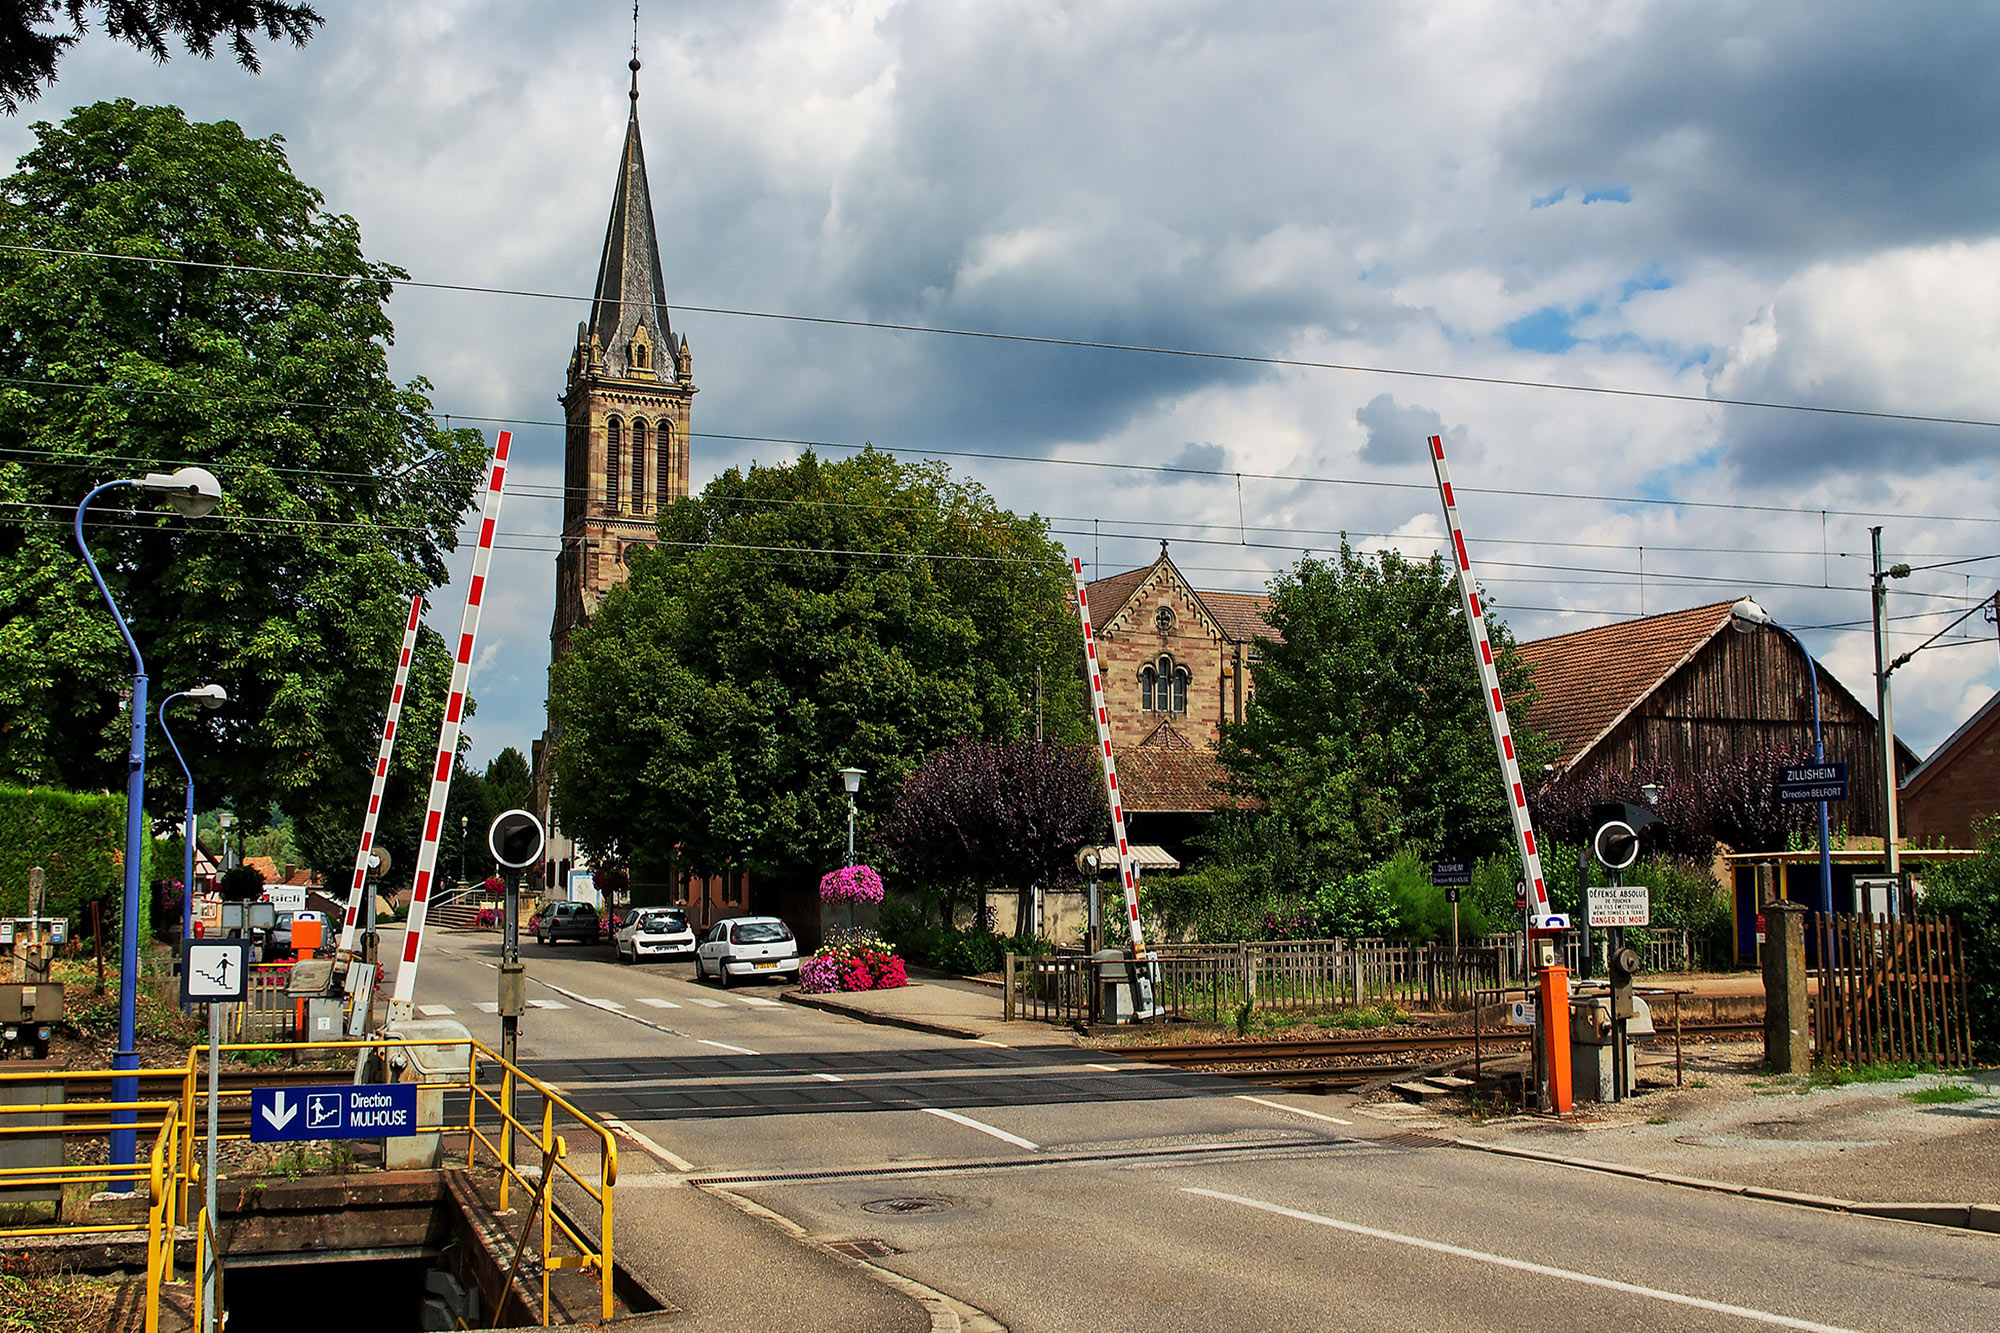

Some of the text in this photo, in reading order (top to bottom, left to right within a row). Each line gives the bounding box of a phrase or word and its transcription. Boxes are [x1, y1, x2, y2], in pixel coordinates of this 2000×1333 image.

[1787, 767, 1836, 781] ZILLISHEIM
[1781, 787, 1841, 799] Direction BELFORT
[1589, 889, 1647, 898] DÉFENSE ABSOLUE
[1591, 915, 1646, 924] DANGER DE MORT
[350, 1092, 392, 1109] Direction
[350, 1110, 407, 1127] MULHOUSE
